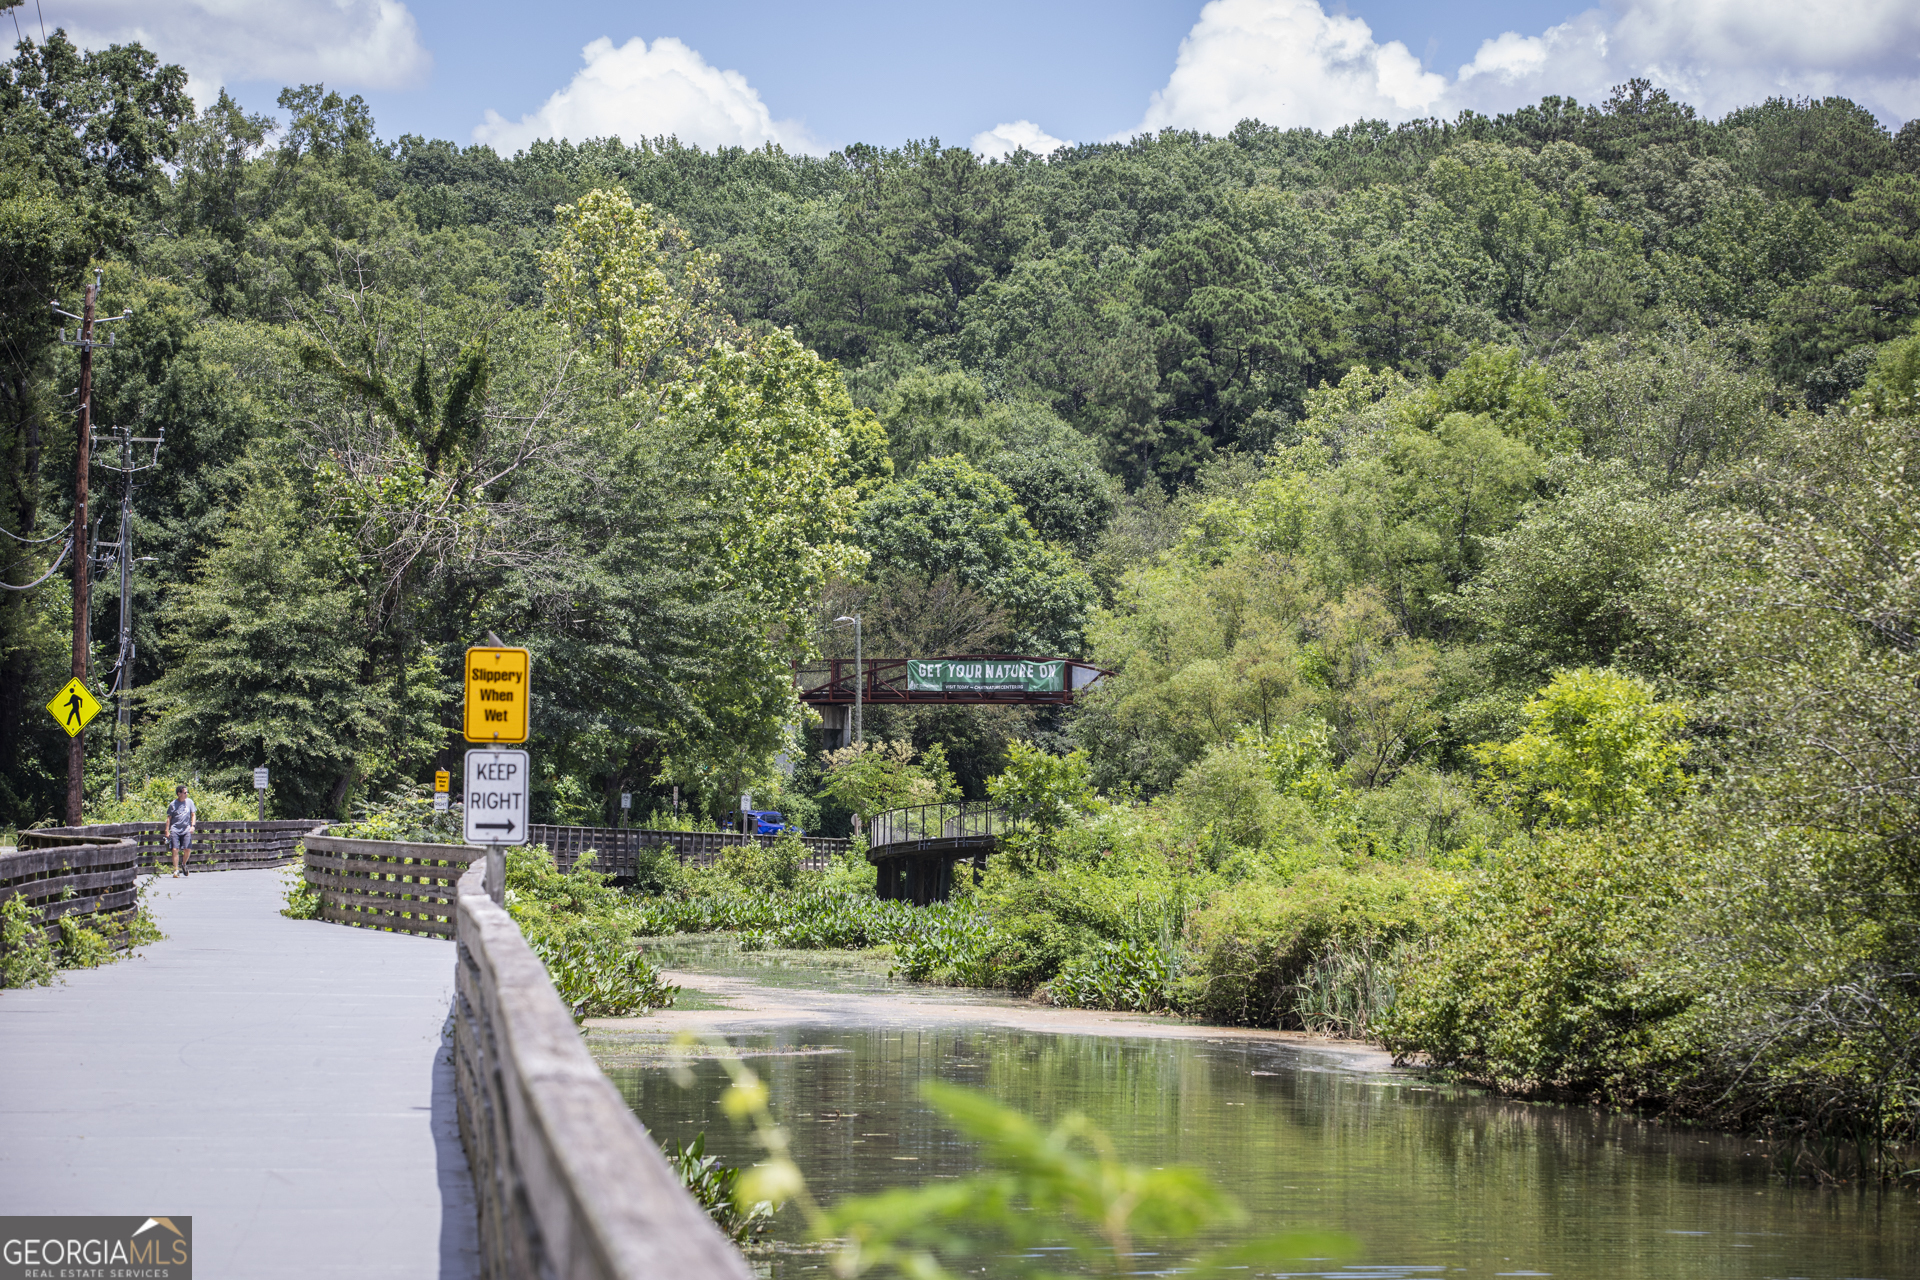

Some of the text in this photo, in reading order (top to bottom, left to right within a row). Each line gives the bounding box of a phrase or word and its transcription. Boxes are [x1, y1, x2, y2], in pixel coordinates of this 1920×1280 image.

[471, 668, 523, 684] Slippery
[918, 663, 1057, 679] GET YOUR NATURE ON
[480, 688, 513, 702] When
[484, 709, 508, 722] Wet
[477, 763, 517, 780] KEEP
[470, 792, 522, 810] RIGHT
